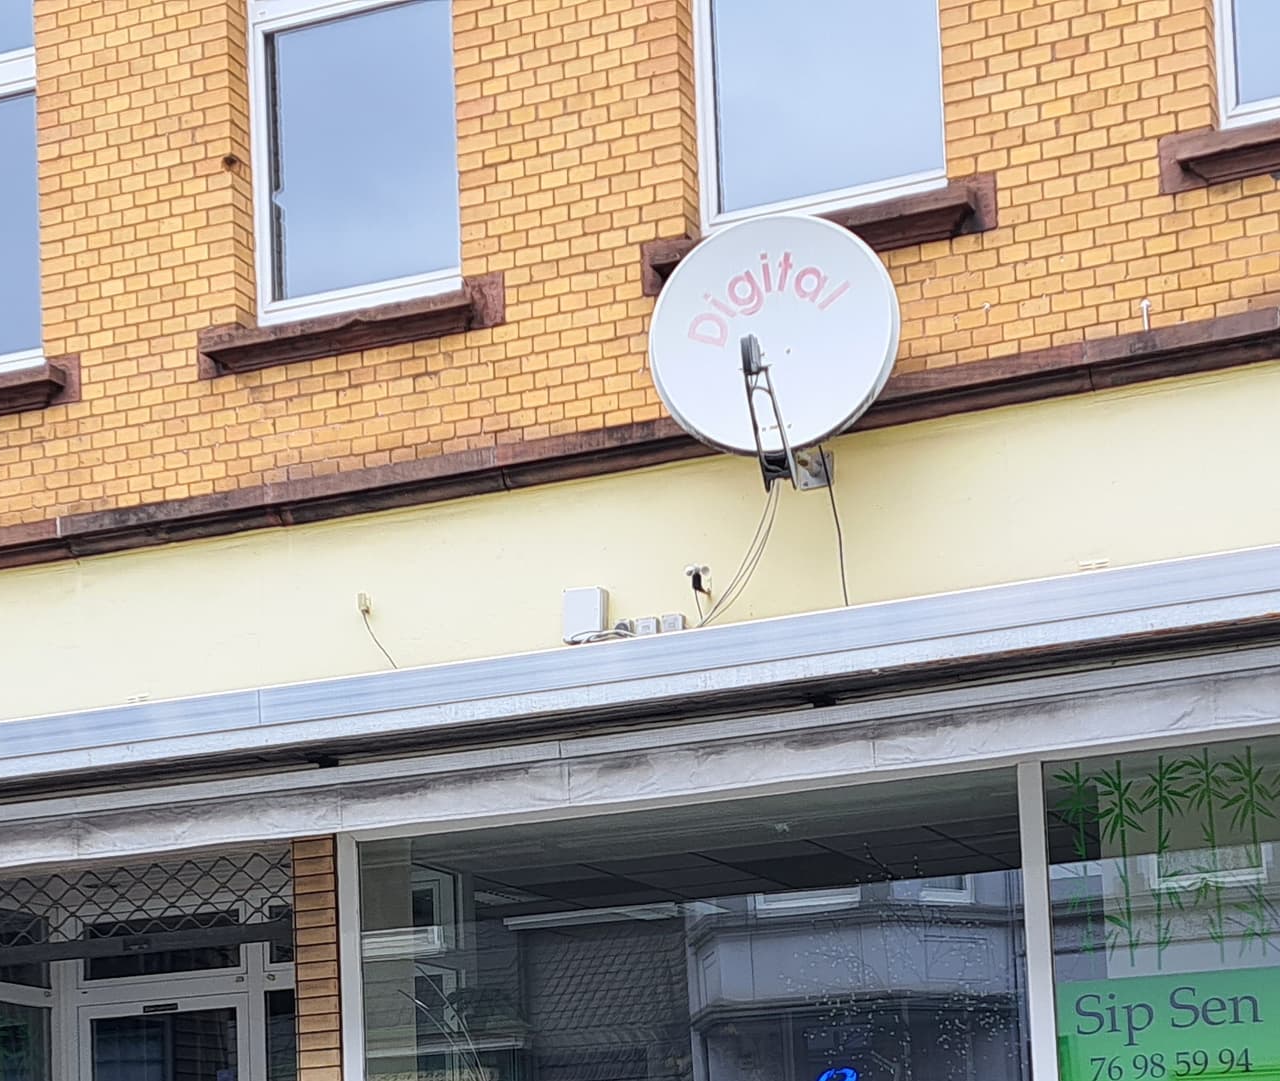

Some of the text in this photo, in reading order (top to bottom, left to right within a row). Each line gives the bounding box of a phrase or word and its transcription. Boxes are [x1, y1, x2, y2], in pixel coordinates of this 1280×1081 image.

[688, 252, 851, 347] Digital
[1075, 987, 1264, 1046] Sip Sen
[1090, 1048, 1253, 1081] 76 98 59 94
